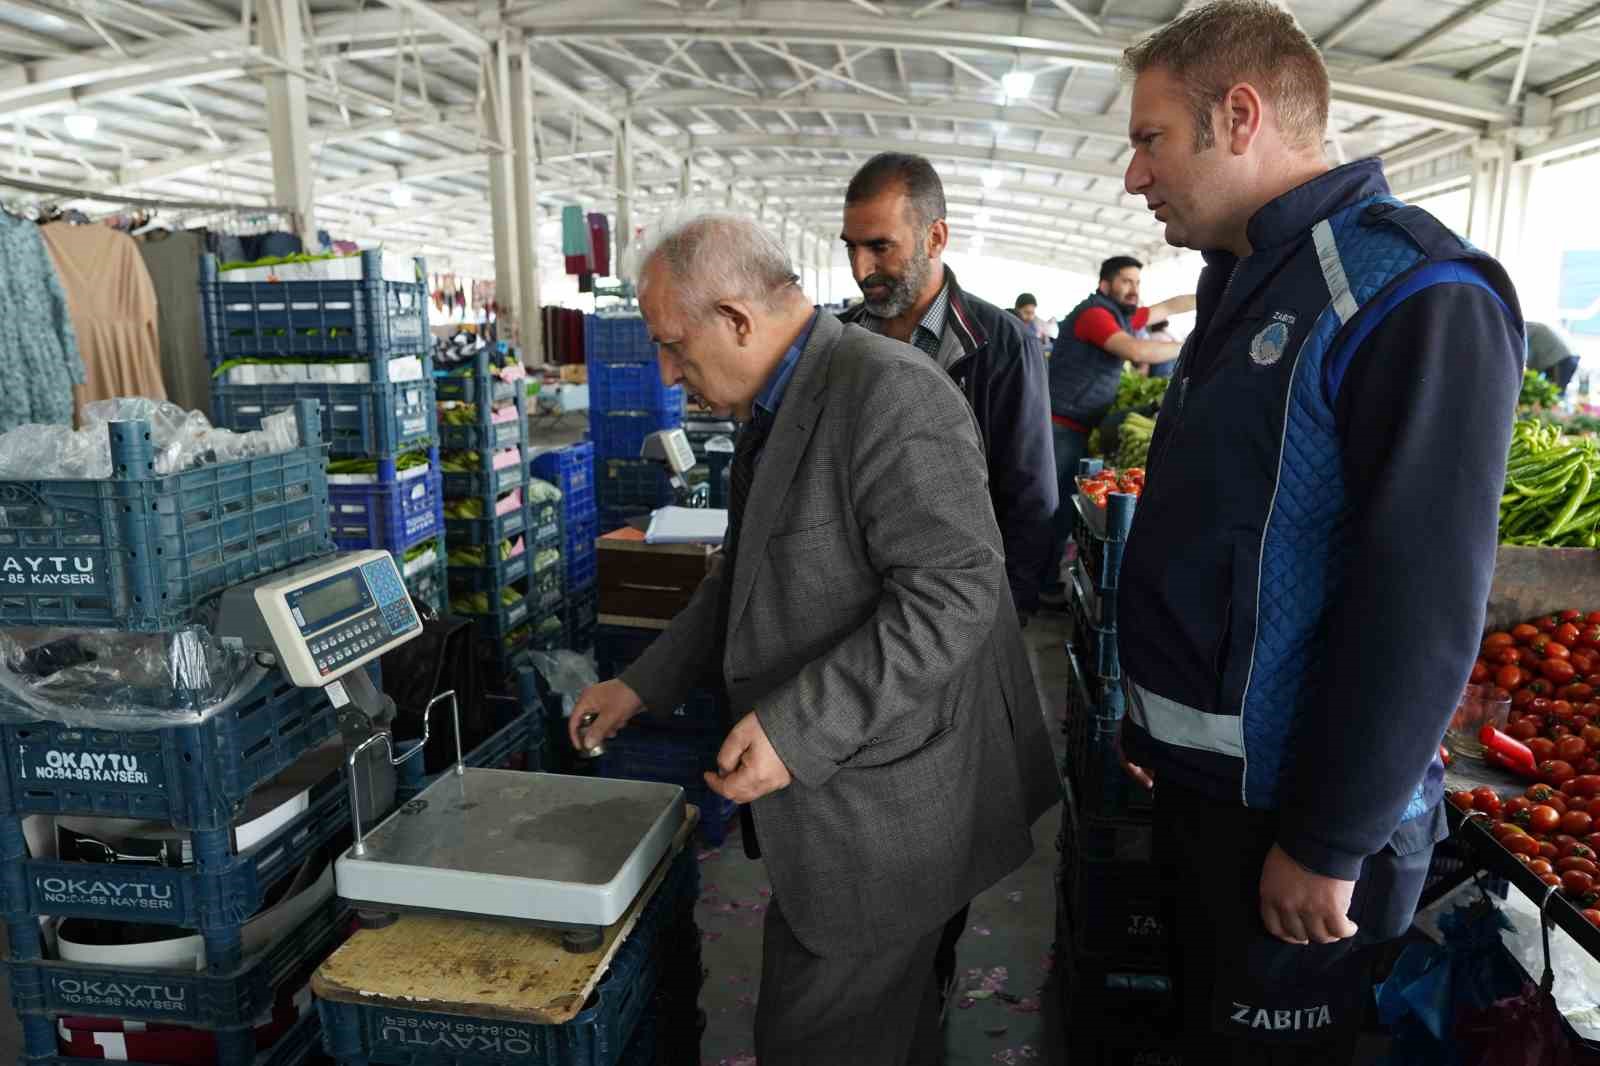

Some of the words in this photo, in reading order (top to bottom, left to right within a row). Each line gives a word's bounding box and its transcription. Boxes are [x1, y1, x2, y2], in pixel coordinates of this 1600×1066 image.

[45, 750, 138, 771] OKAYTU
[43, 878, 171, 899] OKAYTU
[59, 979, 184, 1001] OKAYTU
[1231, 1002, 1332, 1031] ZABITA
[383, 1026, 532, 1055] OKAYTU
